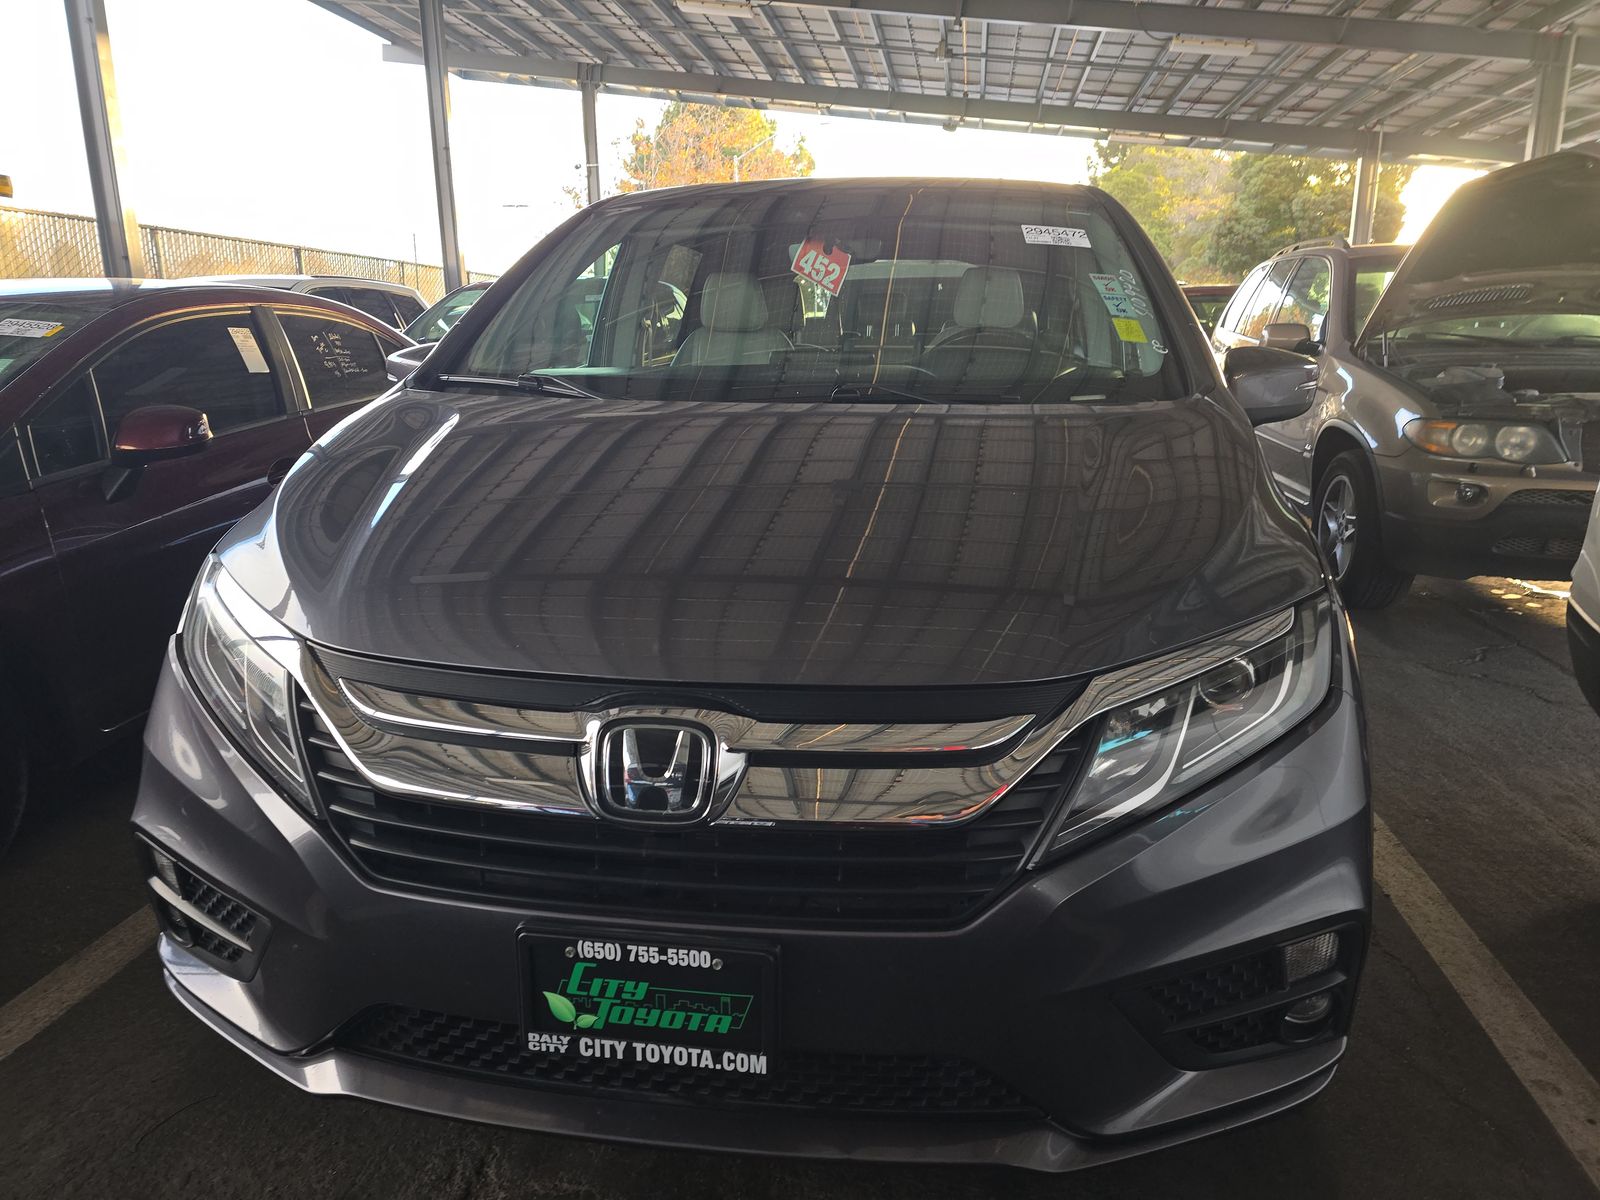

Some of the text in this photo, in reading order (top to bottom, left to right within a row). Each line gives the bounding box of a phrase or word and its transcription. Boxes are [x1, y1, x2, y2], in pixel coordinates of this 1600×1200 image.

[1024, 226, 1087, 238] 2945472
[799, 249, 840, 289] 452
[576, 940, 712, 969] (650) 755-5500
[592, 997, 733, 1034] TOYOTA
[528, 1032, 571, 1045] DALY
[528, 1041, 569, 1054] CITY
[579, 1037, 768, 1075] CITY TOYOTA.COM
